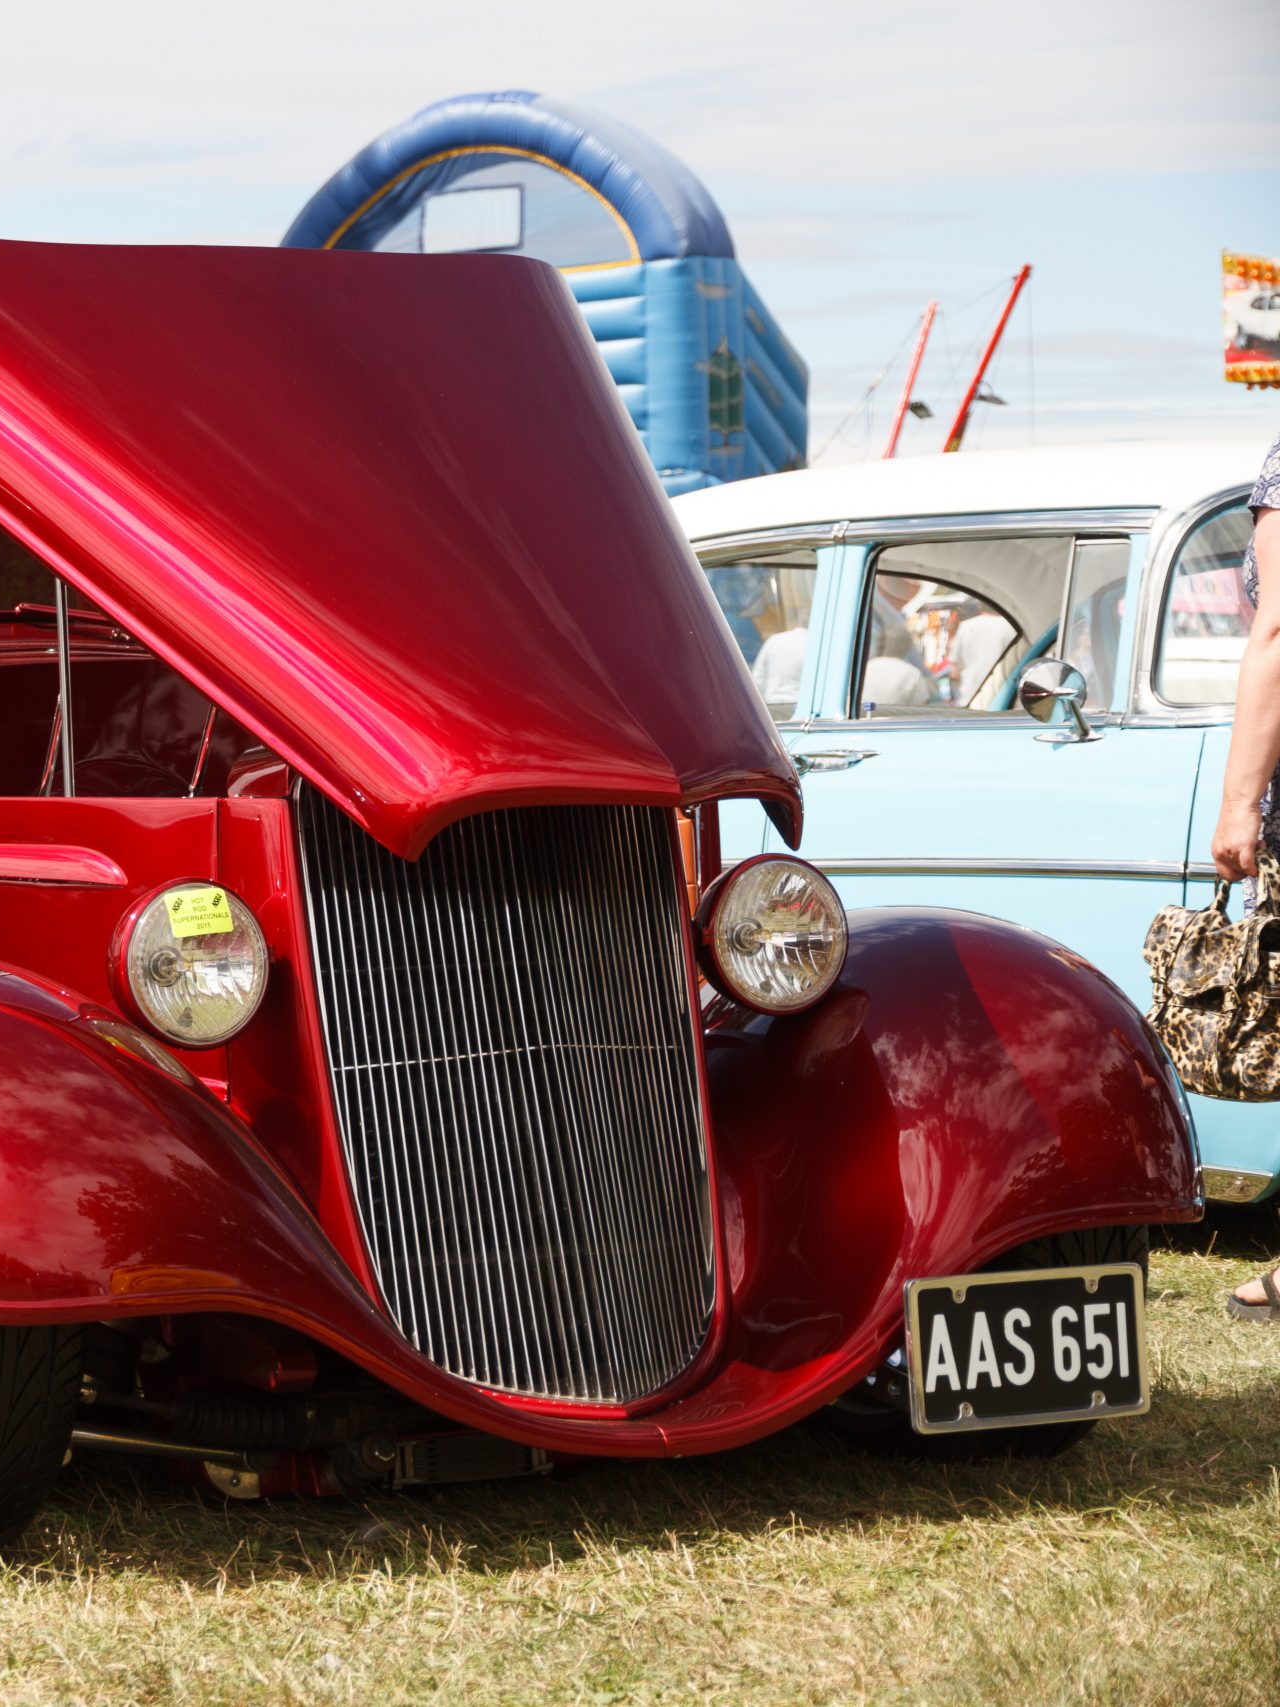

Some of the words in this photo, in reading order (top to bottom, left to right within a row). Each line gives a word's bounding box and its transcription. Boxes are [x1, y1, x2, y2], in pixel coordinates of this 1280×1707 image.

[172, 912, 229, 923] SUPERNATIONALS
[925, 1307, 1036, 1392] AAS
[1051, 1302, 1130, 1382] 651
